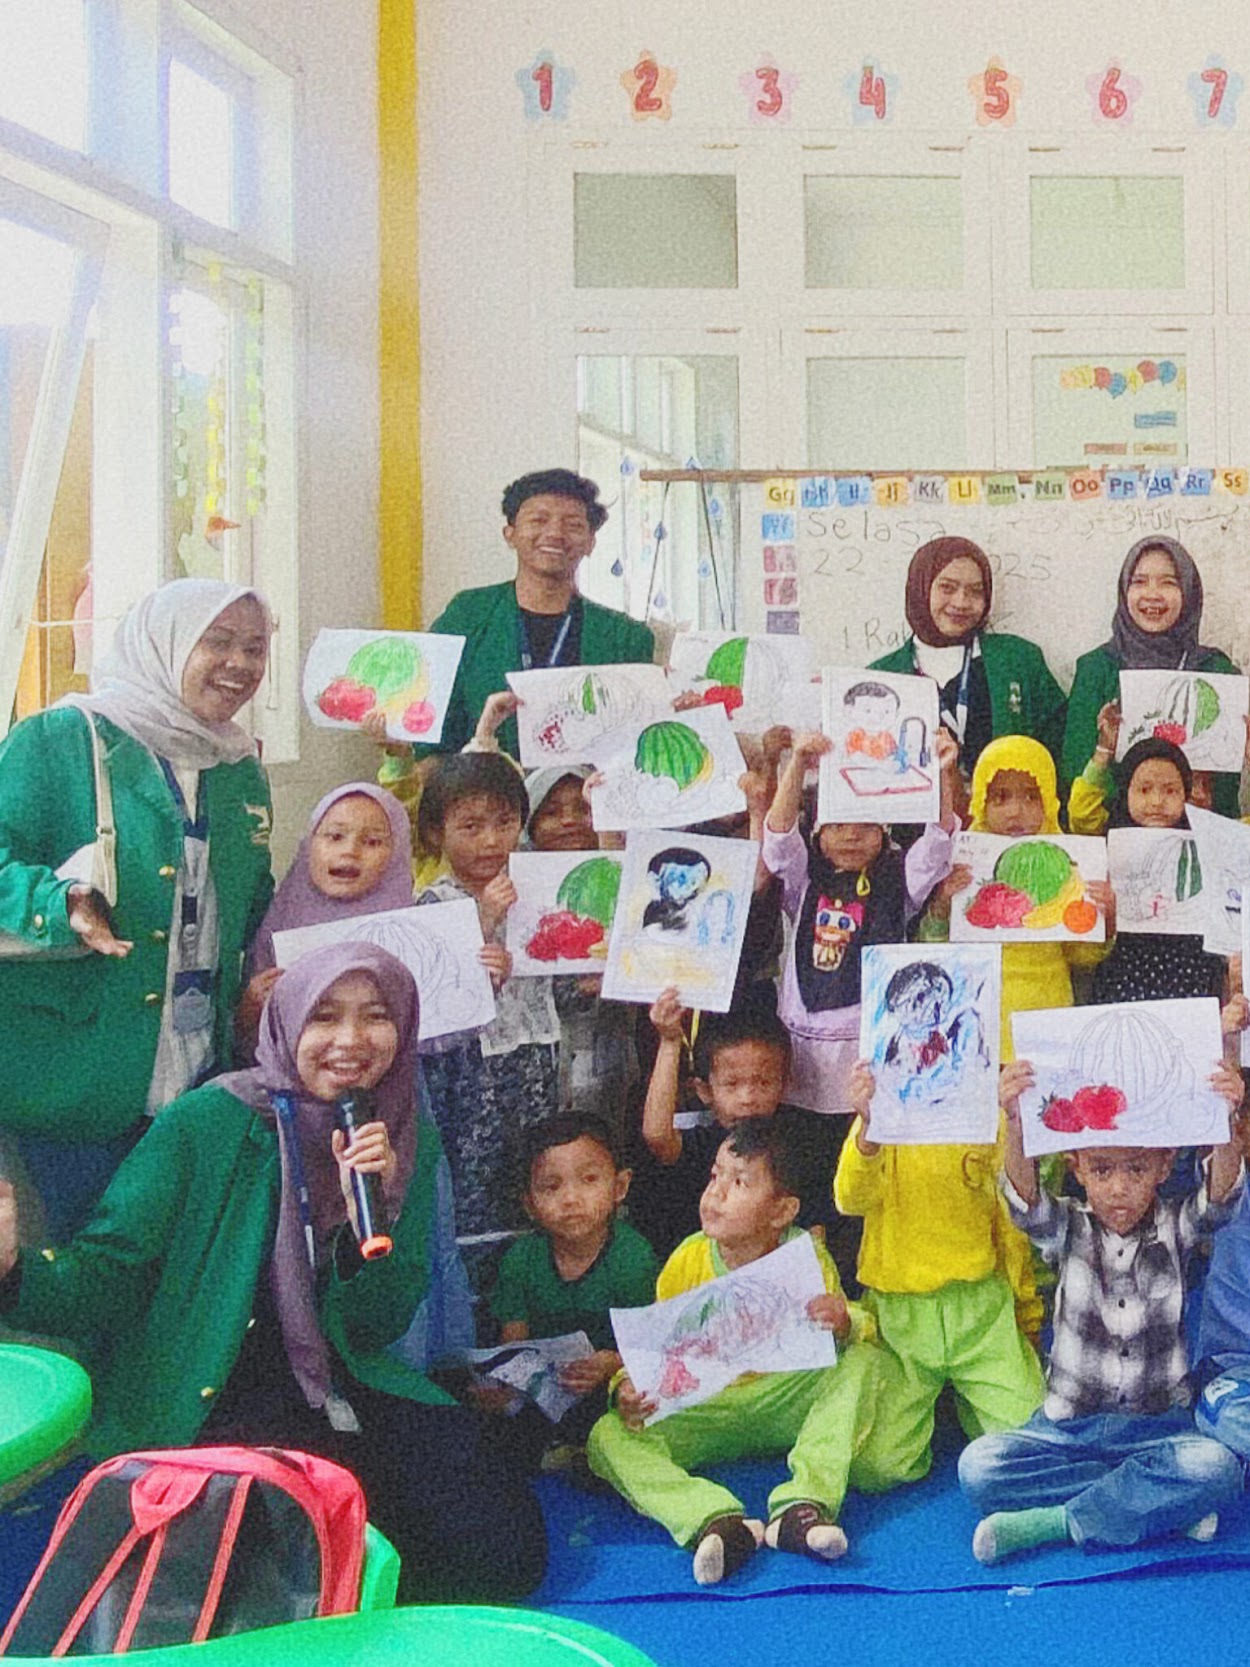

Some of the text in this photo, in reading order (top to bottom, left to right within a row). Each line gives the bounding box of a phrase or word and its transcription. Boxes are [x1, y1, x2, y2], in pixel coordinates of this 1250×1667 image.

[532, 62, 553, 112] 1
[634, 60, 663, 113] 2
[755, 66, 783, 117] 3
[858, 66, 886, 119] 4
[984, 68, 1010, 119] 5
[1098, 67, 1128, 119] 6
[1200, 69, 1228, 118] 7
[988, 480, 1016, 497] Mm
[1035, 480, 1063, 496] Nn
[1071, 478, 1099, 495] Oo
[1109, 477, 1135, 496] Pp
[1222, 473, 1242, 489] Ss
